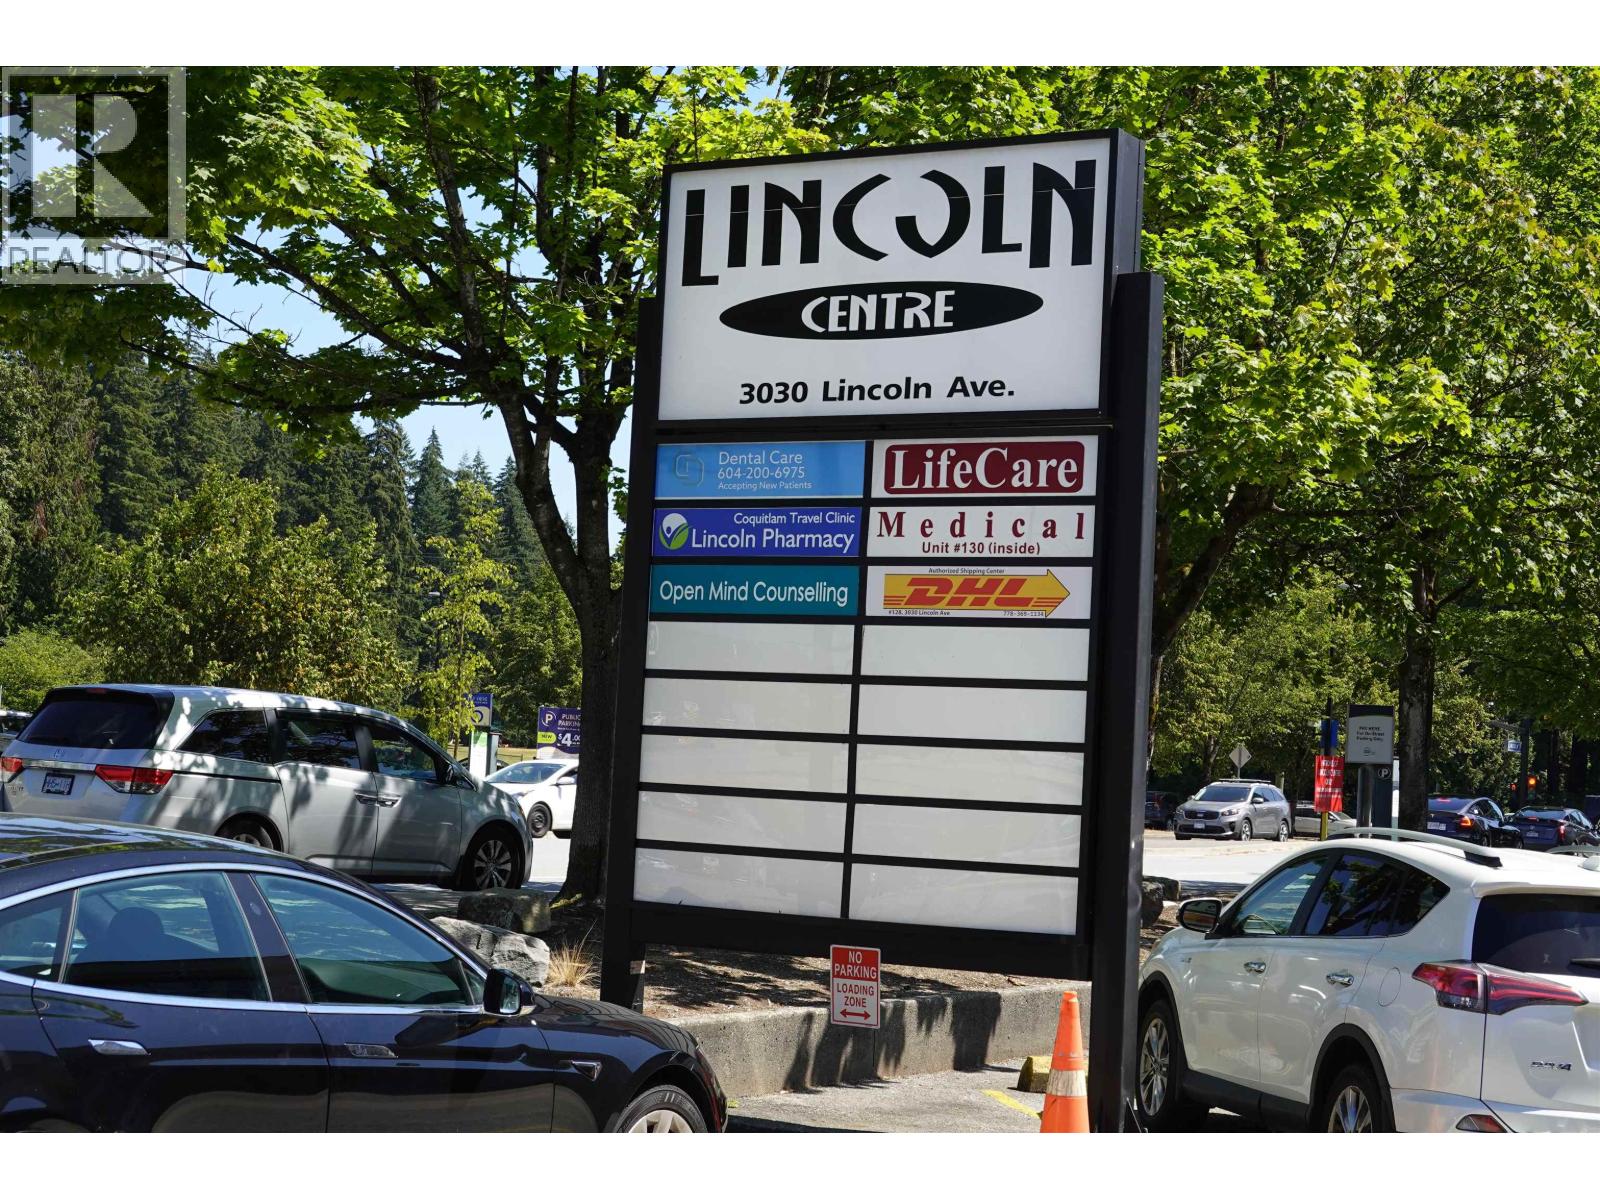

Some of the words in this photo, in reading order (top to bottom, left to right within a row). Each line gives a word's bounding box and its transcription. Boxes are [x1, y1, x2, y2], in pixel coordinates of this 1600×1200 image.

[681, 160, 1097, 287] LINCOLN
[801, 289, 956, 335] CENTRE
[739, 381, 809, 405] 3030
[821, 376, 933, 402] Lincoln
[946, 375, 1016, 399] Ave.
[718, 451, 766, 465] Dental
[769, 450, 803, 465] Care
[717, 466, 806, 480] 604-200-6975
[889, 447, 1079, 489] LifeCare
[718, 481, 758, 491] Accepting
[759, 481, 778, 490] New
[779, 480, 813, 490] Patients
[733, 512, 787, 527] Coquitlam
[789, 511, 823, 525] Travel
[825, 511, 856, 524] Clinic
[876, 510, 1085, 540] Medical
[691, 529, 756, 549] Lincoln
[762, 528, 855, 554] Pharmacy
[922, 541, 951, 554] Unit
[953, 541, 985, 555] #130
[988, 541, 1041, 556] (inside)
[928, 567, 959, 575] Authorized
[960, 567, 985, 576] Shipping
[986, 567, 1005, 575] Center
[659, 580, 705, 605] Open
[708, 580, 749, 602] Mind
[753, 581, 849, 608] Counselling
[903, 577, 1034, 607] DHL
[918, 609, 939, 617] Lincoln
[557, 719, 581, 727] PARKIN
[848, 951, 863, 964] NO
[834, 963, 877, 979] PARKING
[837, 983, 874, 996] LOADING
[844, 996, 867, 1008] ZONE
